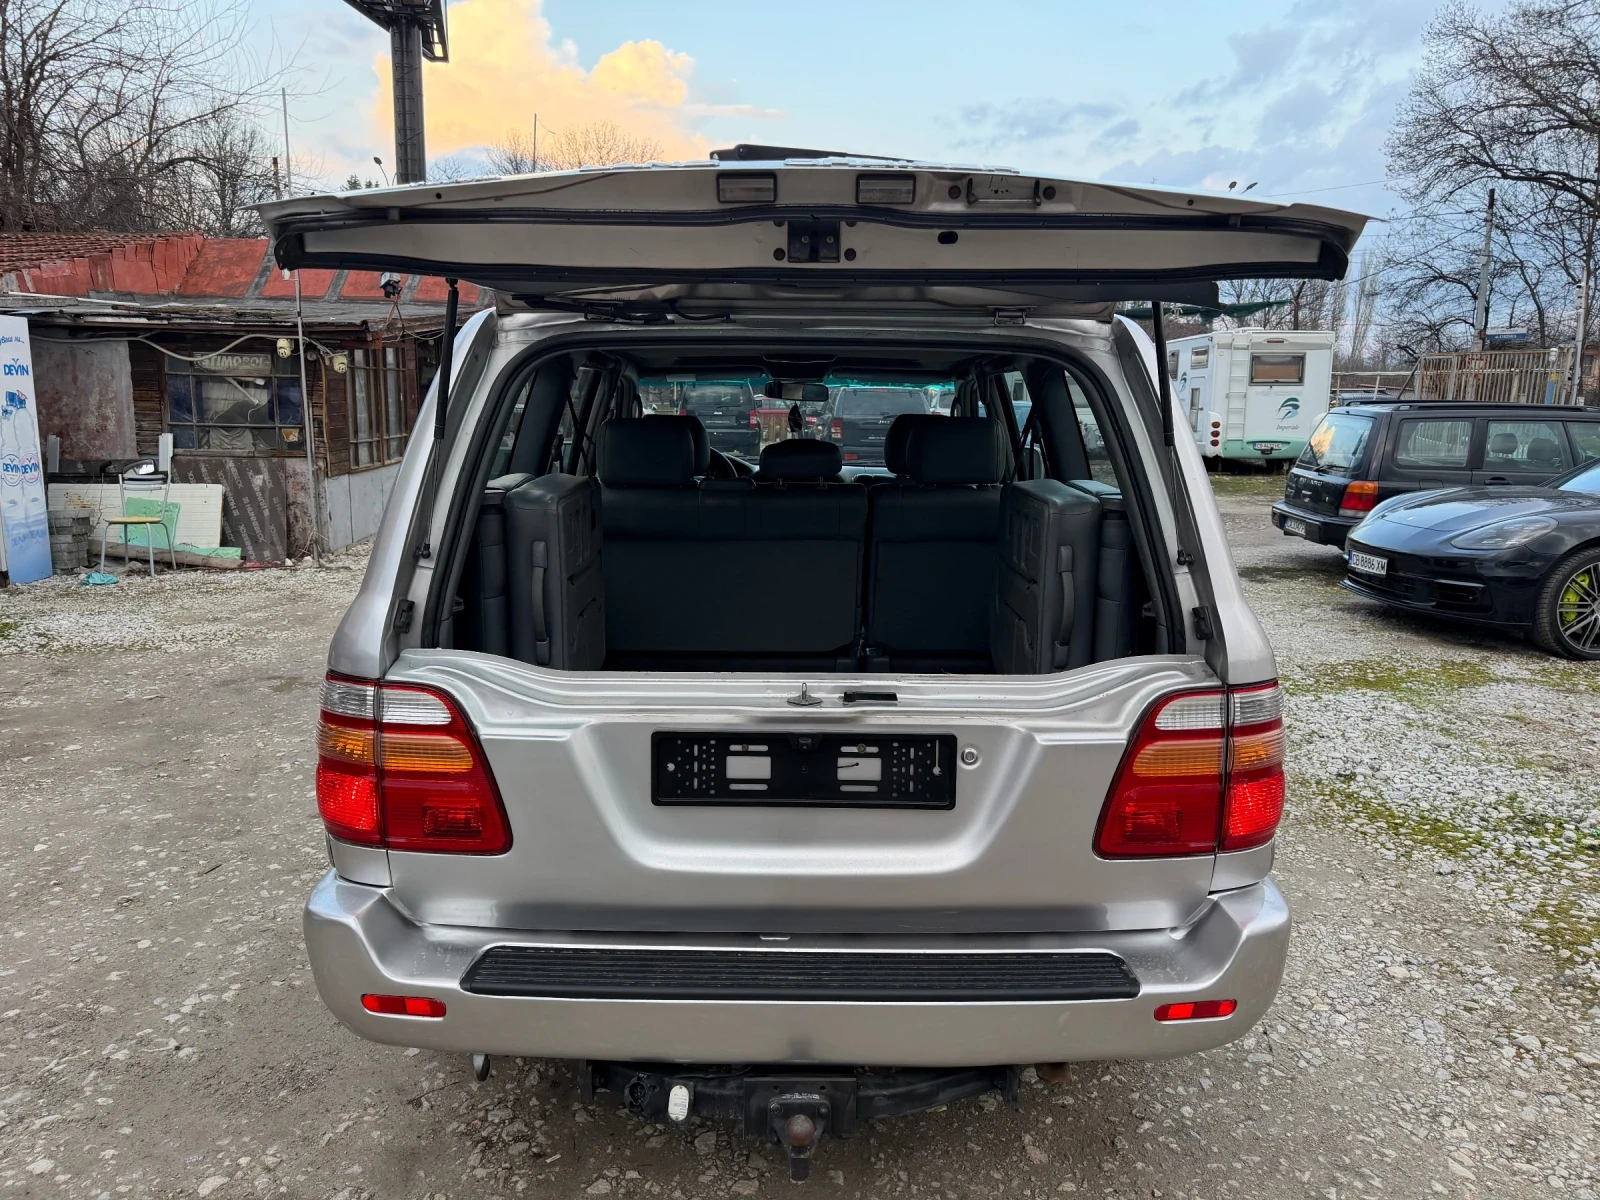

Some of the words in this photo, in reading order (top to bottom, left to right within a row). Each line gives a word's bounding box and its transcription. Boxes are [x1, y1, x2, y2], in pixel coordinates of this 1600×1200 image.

[4, 364, 29, 376] DEVIN
[21, 463, 39, 475] DEVIN
[1353, 554, 1360, 566] CB
[1361, 556, 1375, 570] 8886
[1376, 560, 1386, 573] XM
